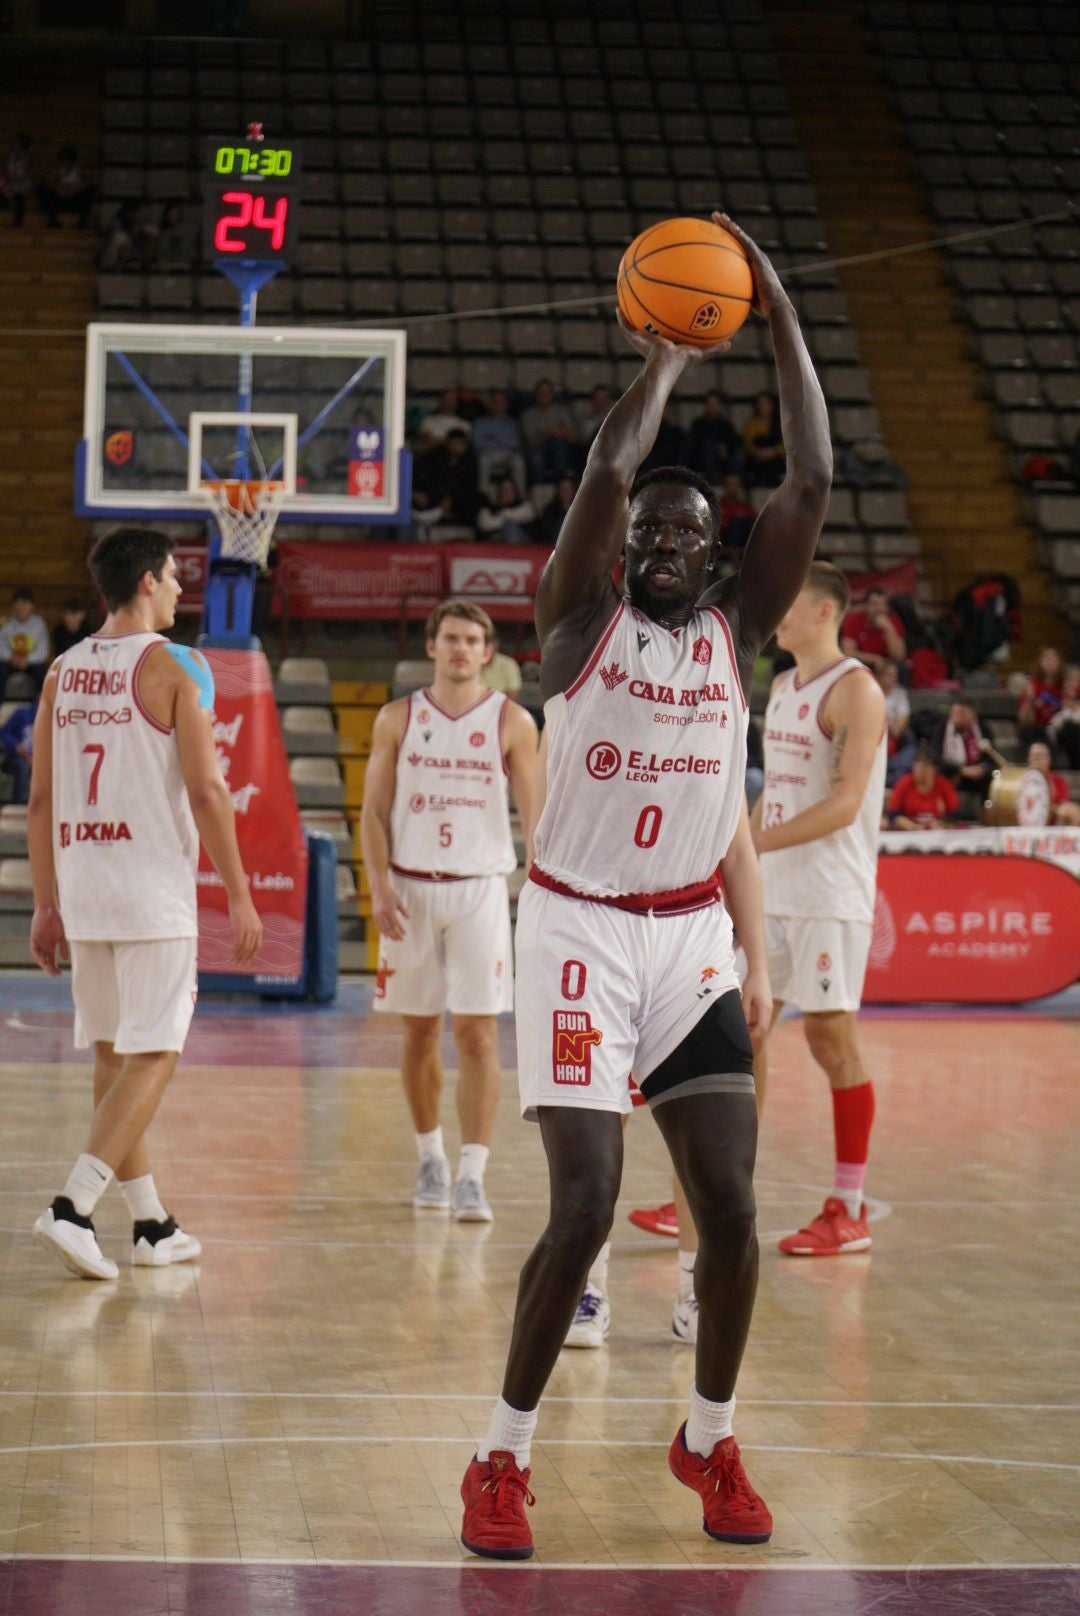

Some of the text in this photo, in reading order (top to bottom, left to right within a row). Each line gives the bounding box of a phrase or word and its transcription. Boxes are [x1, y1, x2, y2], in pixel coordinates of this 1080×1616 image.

[215, 147, 292, 176] 07:30
[214, 192, 288, 252] 24
[62, 668, 128, 695] ORENGA
[628, 680, 729, 707] CAJA RURAL
[83, 743, 105, 805] 7
[628, 750, 721, 775] E.Leclerc
[626, 770, 658, 783] LEÓN
[439, 823, 453, 848] 5
[634, 804, 663, 849] 0
[927, 941, 1031, 958] ACADEMY
[561, 959, 587, 1001] 0
[557, 1013, 587, 1032] BUN
[556, 1064, 586, 1083] HAM
